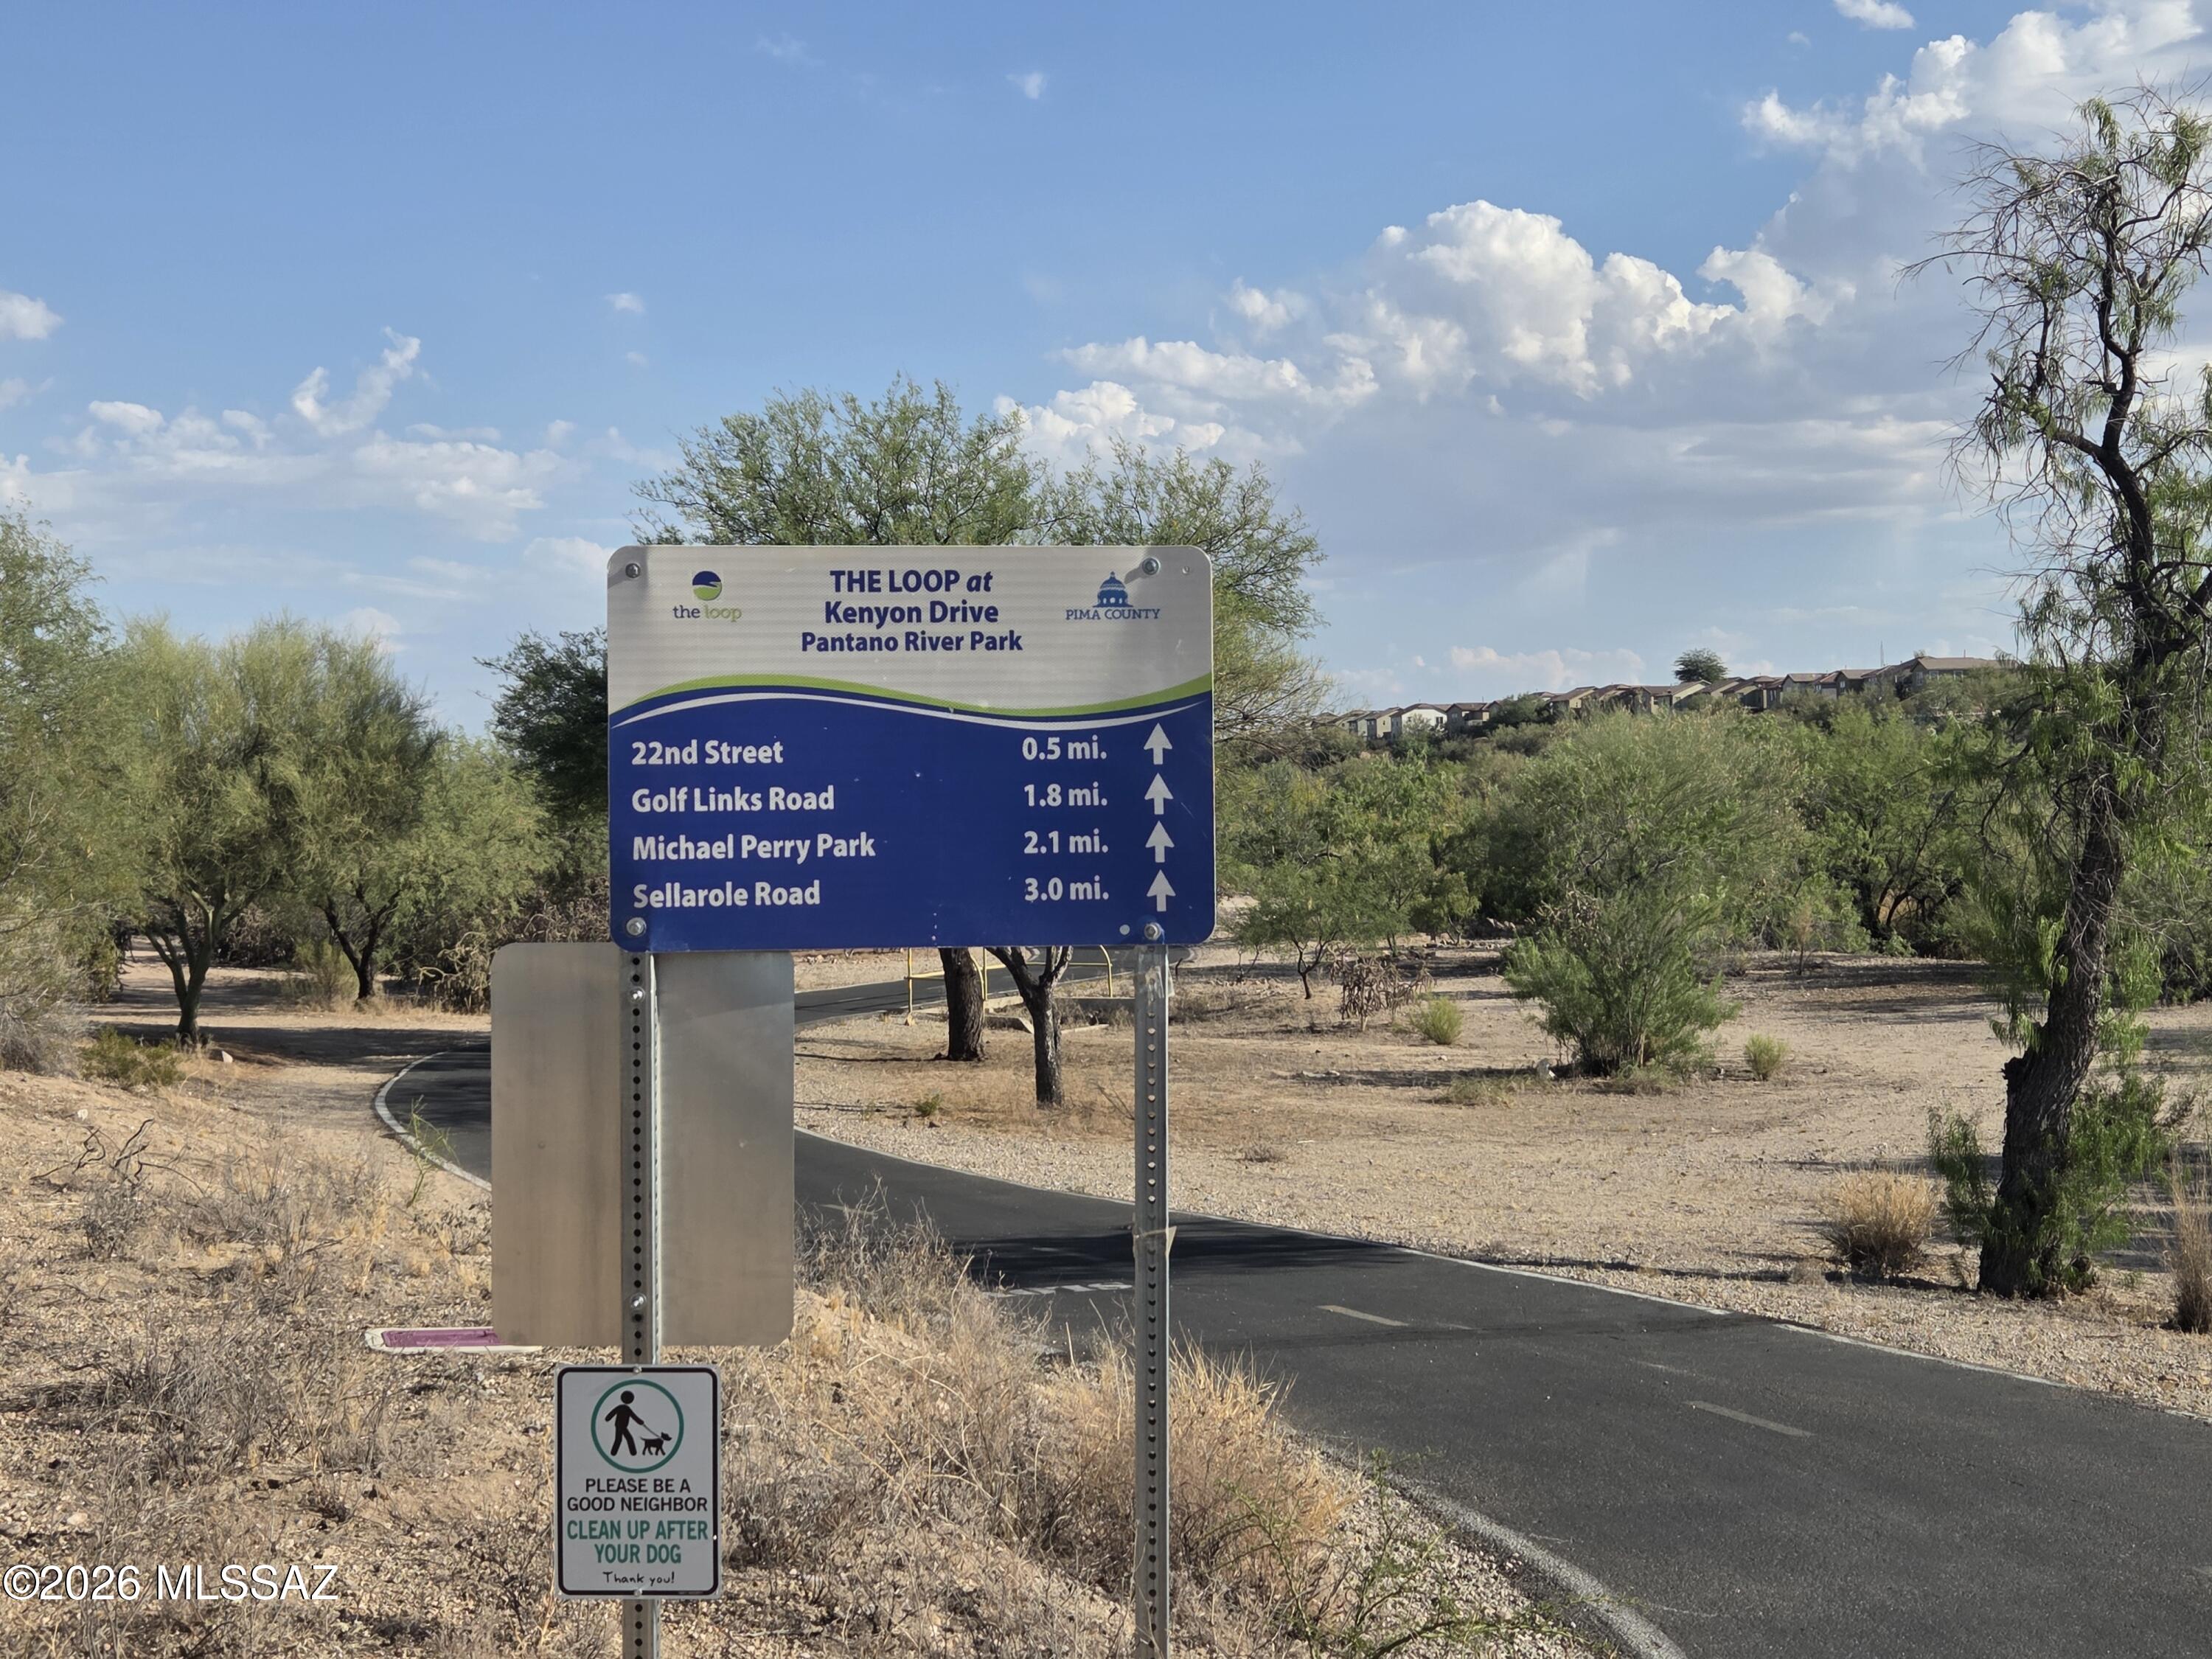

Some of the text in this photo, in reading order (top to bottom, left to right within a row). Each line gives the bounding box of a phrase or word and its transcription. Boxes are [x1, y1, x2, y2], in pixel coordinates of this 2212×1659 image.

[830, 570, 992, 592] THE LOOP at
[672, 605, 742, 622] the loop
[825, 599, 998, 628] Kenyon Drive
[1066, 609, 1160, 620] PIMA COUNTY
[802, 630, 1023, 652] Pantano River Park
[632, 740, 783, 765] 22nd Street
[1023, 735, 1107, 760] 0.5 mi.
[633, 785, 834, 812] Golf Links Road
[1024, 783, 1107, 807] 1.8 mi.
[633, 832, 875, 864] Michael Perry Park
[1024, 830, 1108, 853] 2.1 mi.
[634, 880, 820, 908] Sellarole Road
[1025, 877, 1108, 902] 3.0 mi.
[586, 1478, 690, 1492] PLEASE BE A
[568, 1497, 707, 1511] GOOD NEIGHBOR
[568, 1520, 708, 1540] CLEAN UP AFTER
[594, 1544, 681, 1563] YOUR DOG
[602, 1571, 674, 1586] Thank you!
